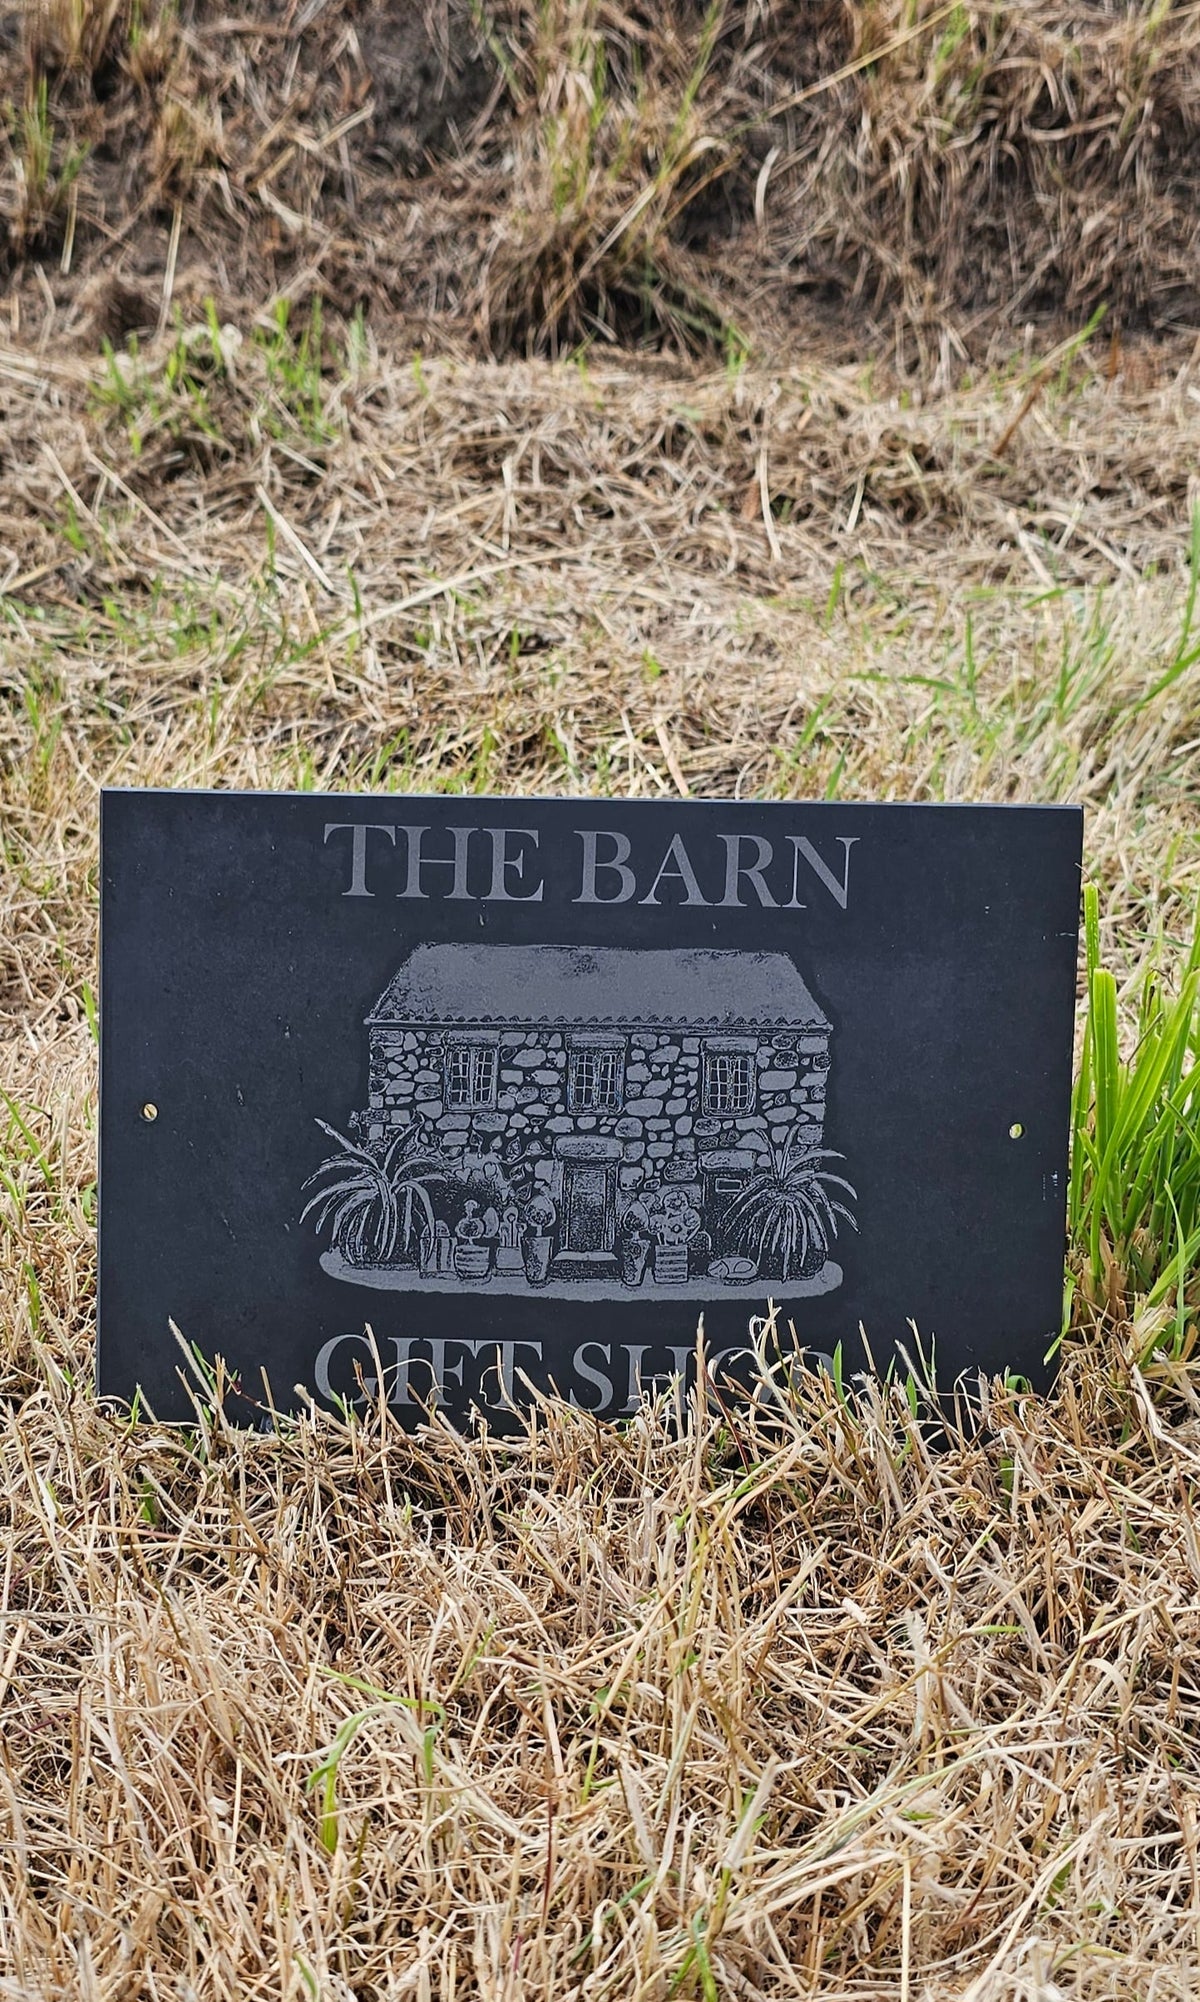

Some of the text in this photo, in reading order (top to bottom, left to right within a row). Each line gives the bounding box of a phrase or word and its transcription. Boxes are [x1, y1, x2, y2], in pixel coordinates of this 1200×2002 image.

[323, 823, 861, 909] THE BARN
[314, 1334, 543, 1406] GIFT
